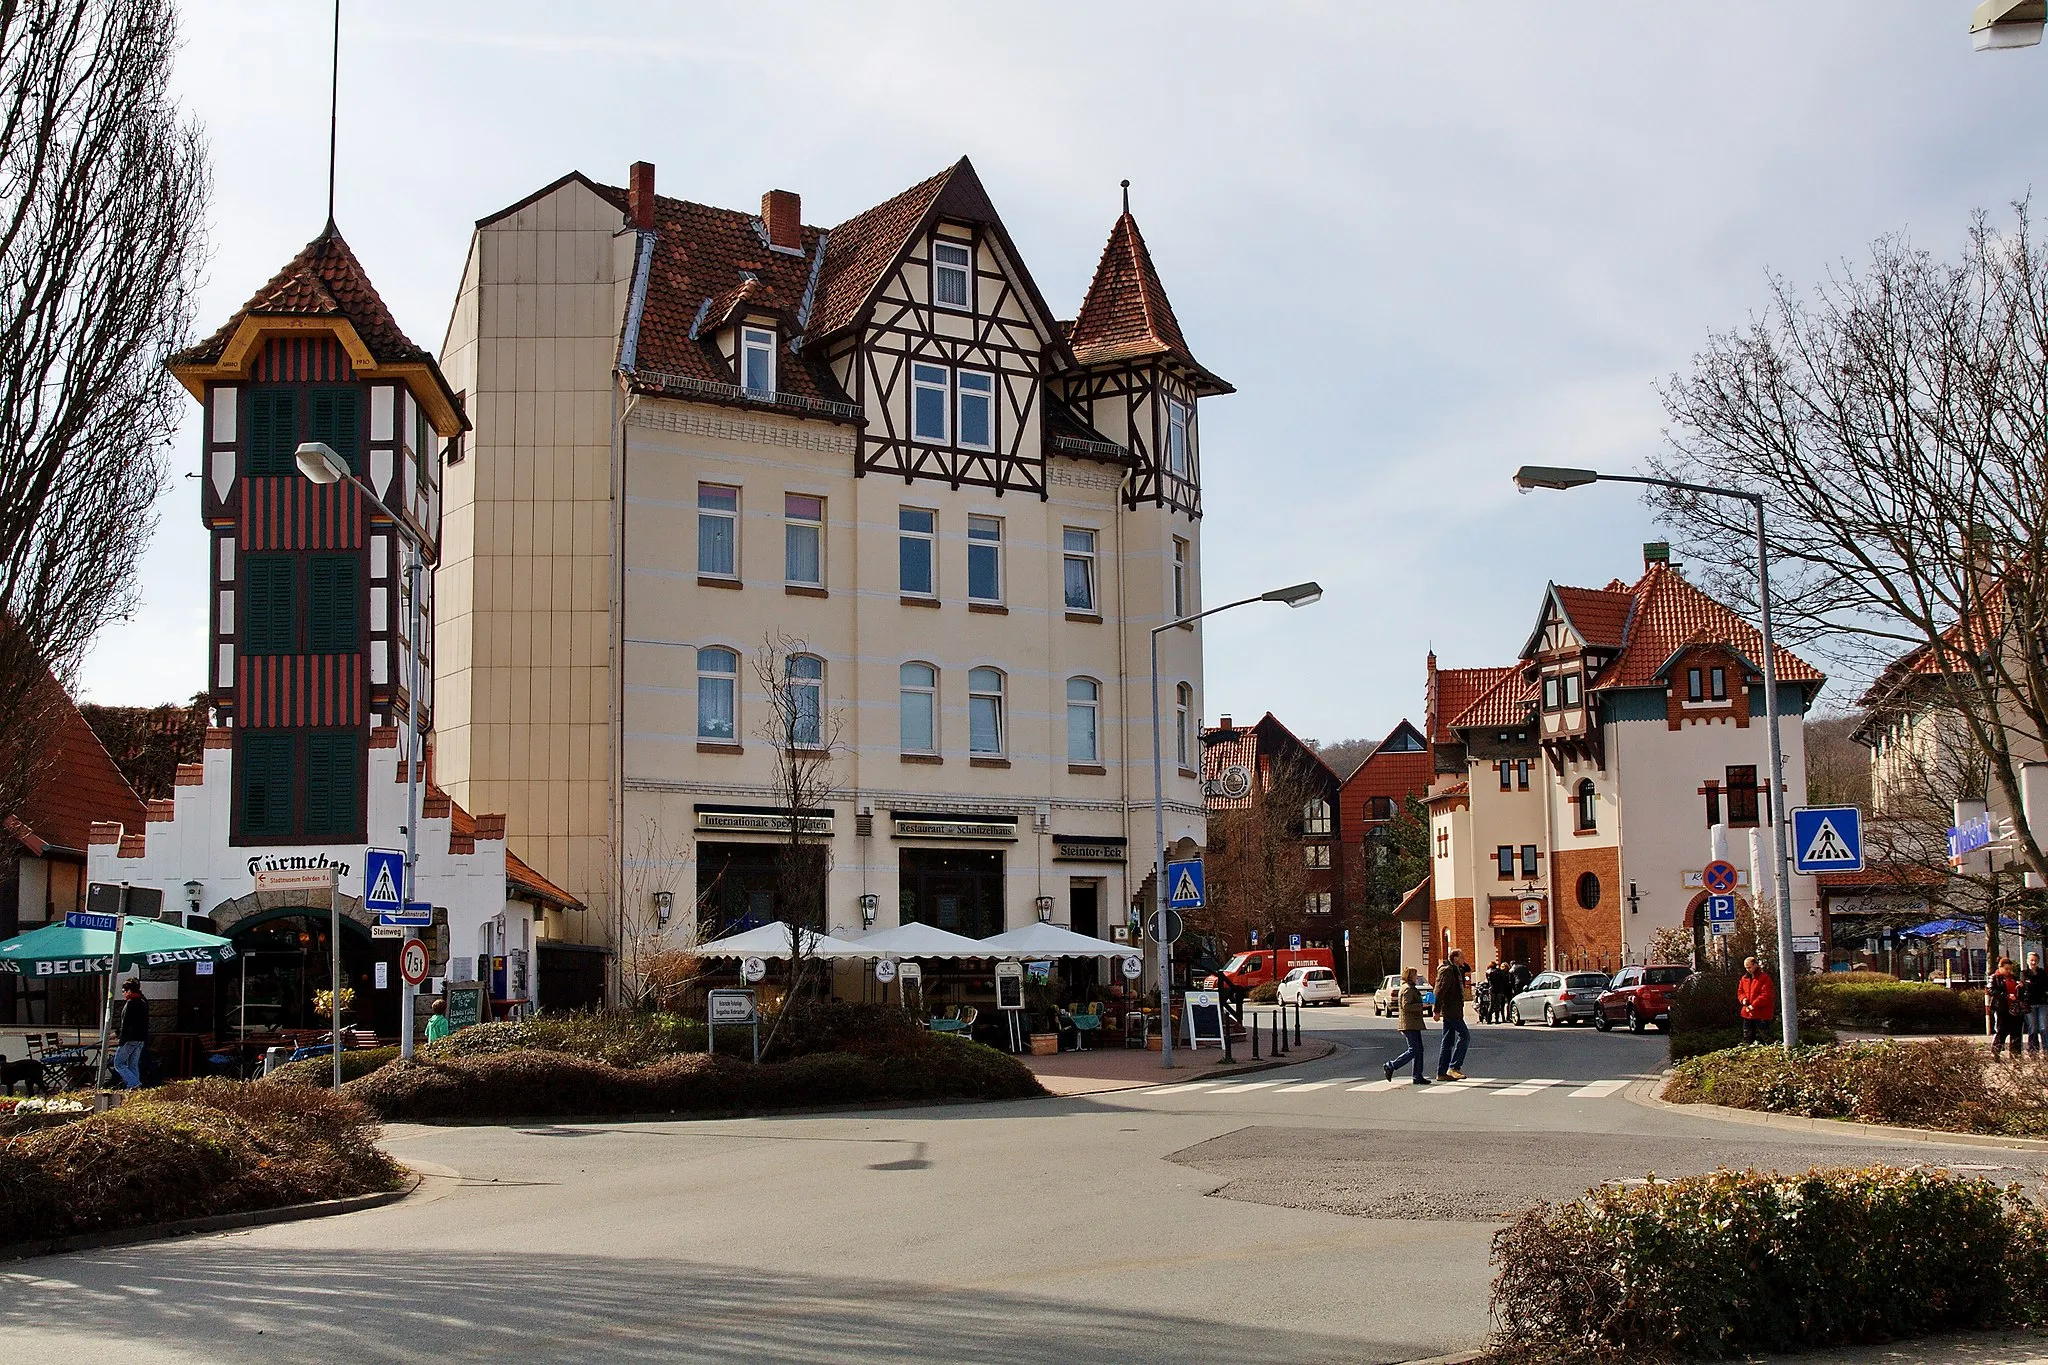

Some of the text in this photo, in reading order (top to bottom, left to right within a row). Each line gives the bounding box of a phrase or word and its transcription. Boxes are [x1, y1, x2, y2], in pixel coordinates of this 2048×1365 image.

[705, 816, 768, 827] Internationale
[900, 823, 1012, 835] Restaurant Schnitzelhaus
[80, 915, 113, 928] POLIZEI
[373, 927, 402, 936] Steinweg
